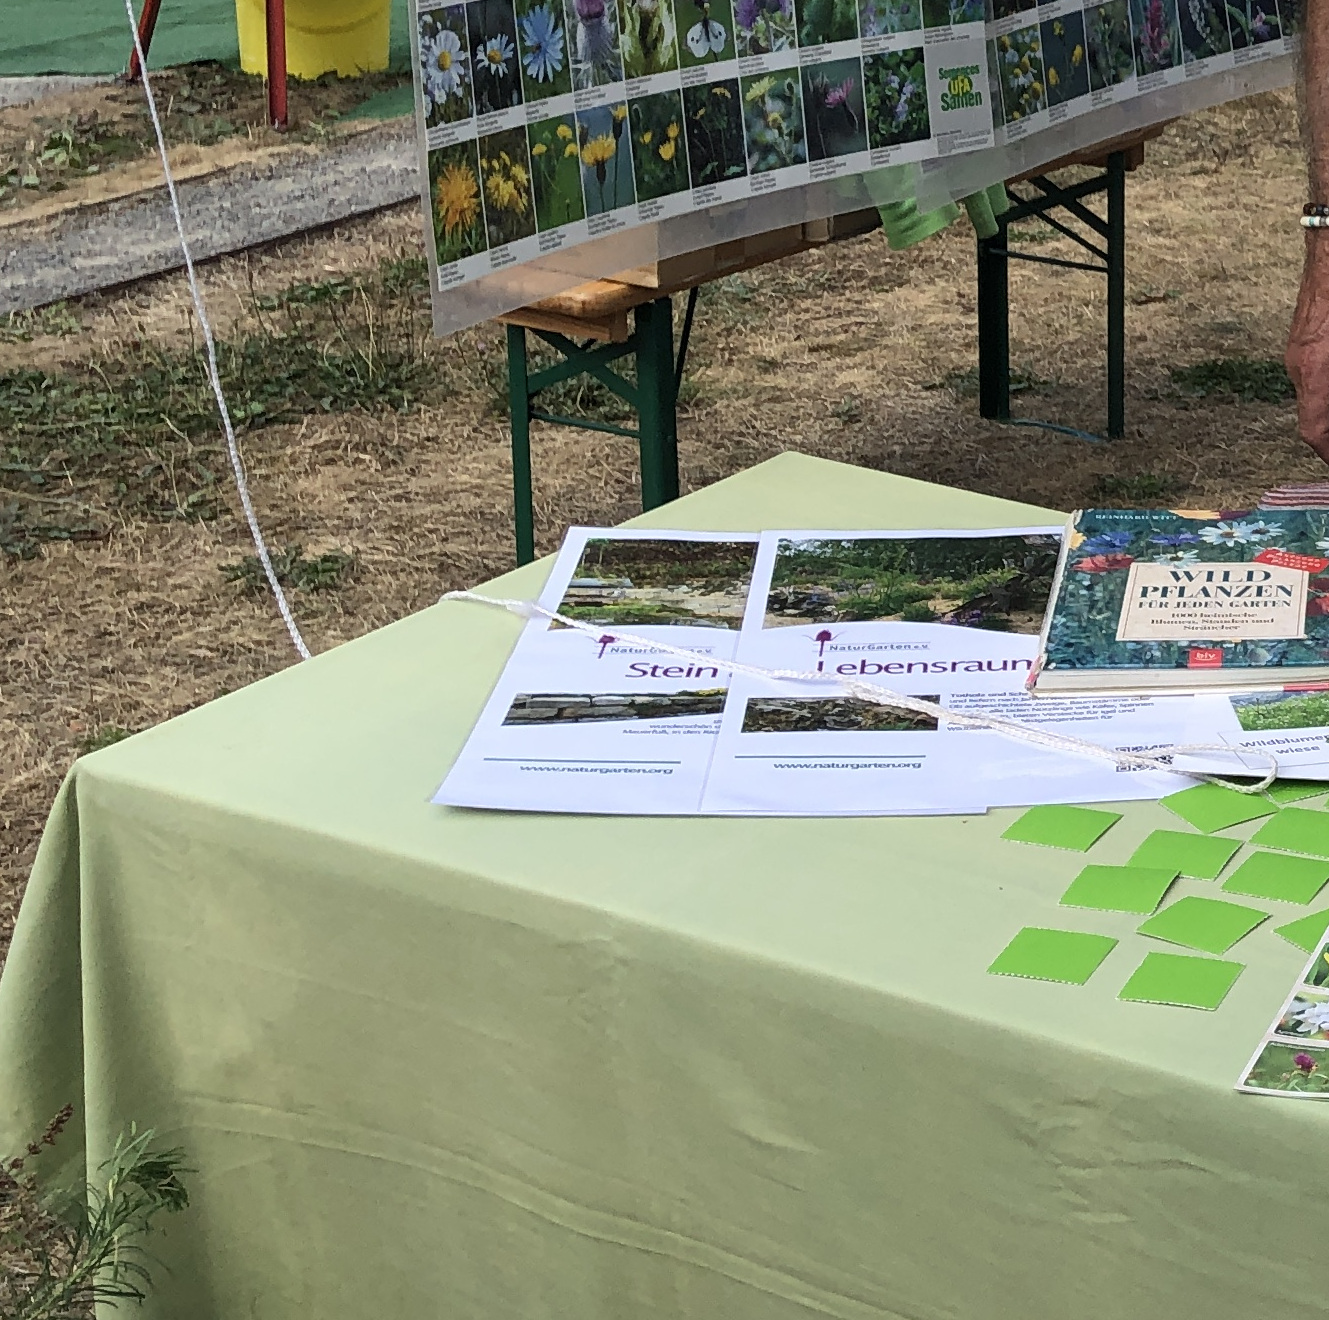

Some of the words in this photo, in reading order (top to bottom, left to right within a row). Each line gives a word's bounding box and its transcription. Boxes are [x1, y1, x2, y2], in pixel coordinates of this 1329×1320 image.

[940, 64, 981, 81] Semences
[950, 75, 971, 97] UFA
[940, 91, 983, 112] Samen
[1169, 570, 1273, 584] WILD
[1139, 585, 1295, 599] PFLANZEN
[1138, 600, 1170, 609] FÜR
[1173, 600, 1225, 609] JEDEN
[1228, 599, 1292, 609] GARTEN
[829, 642, 912, 652] NaturGarten
[625, 662, 719, 679] Stein
[1275, 745, 1321, 755] wiese
[773, 761, 923, 771] www.naturgarten.org
